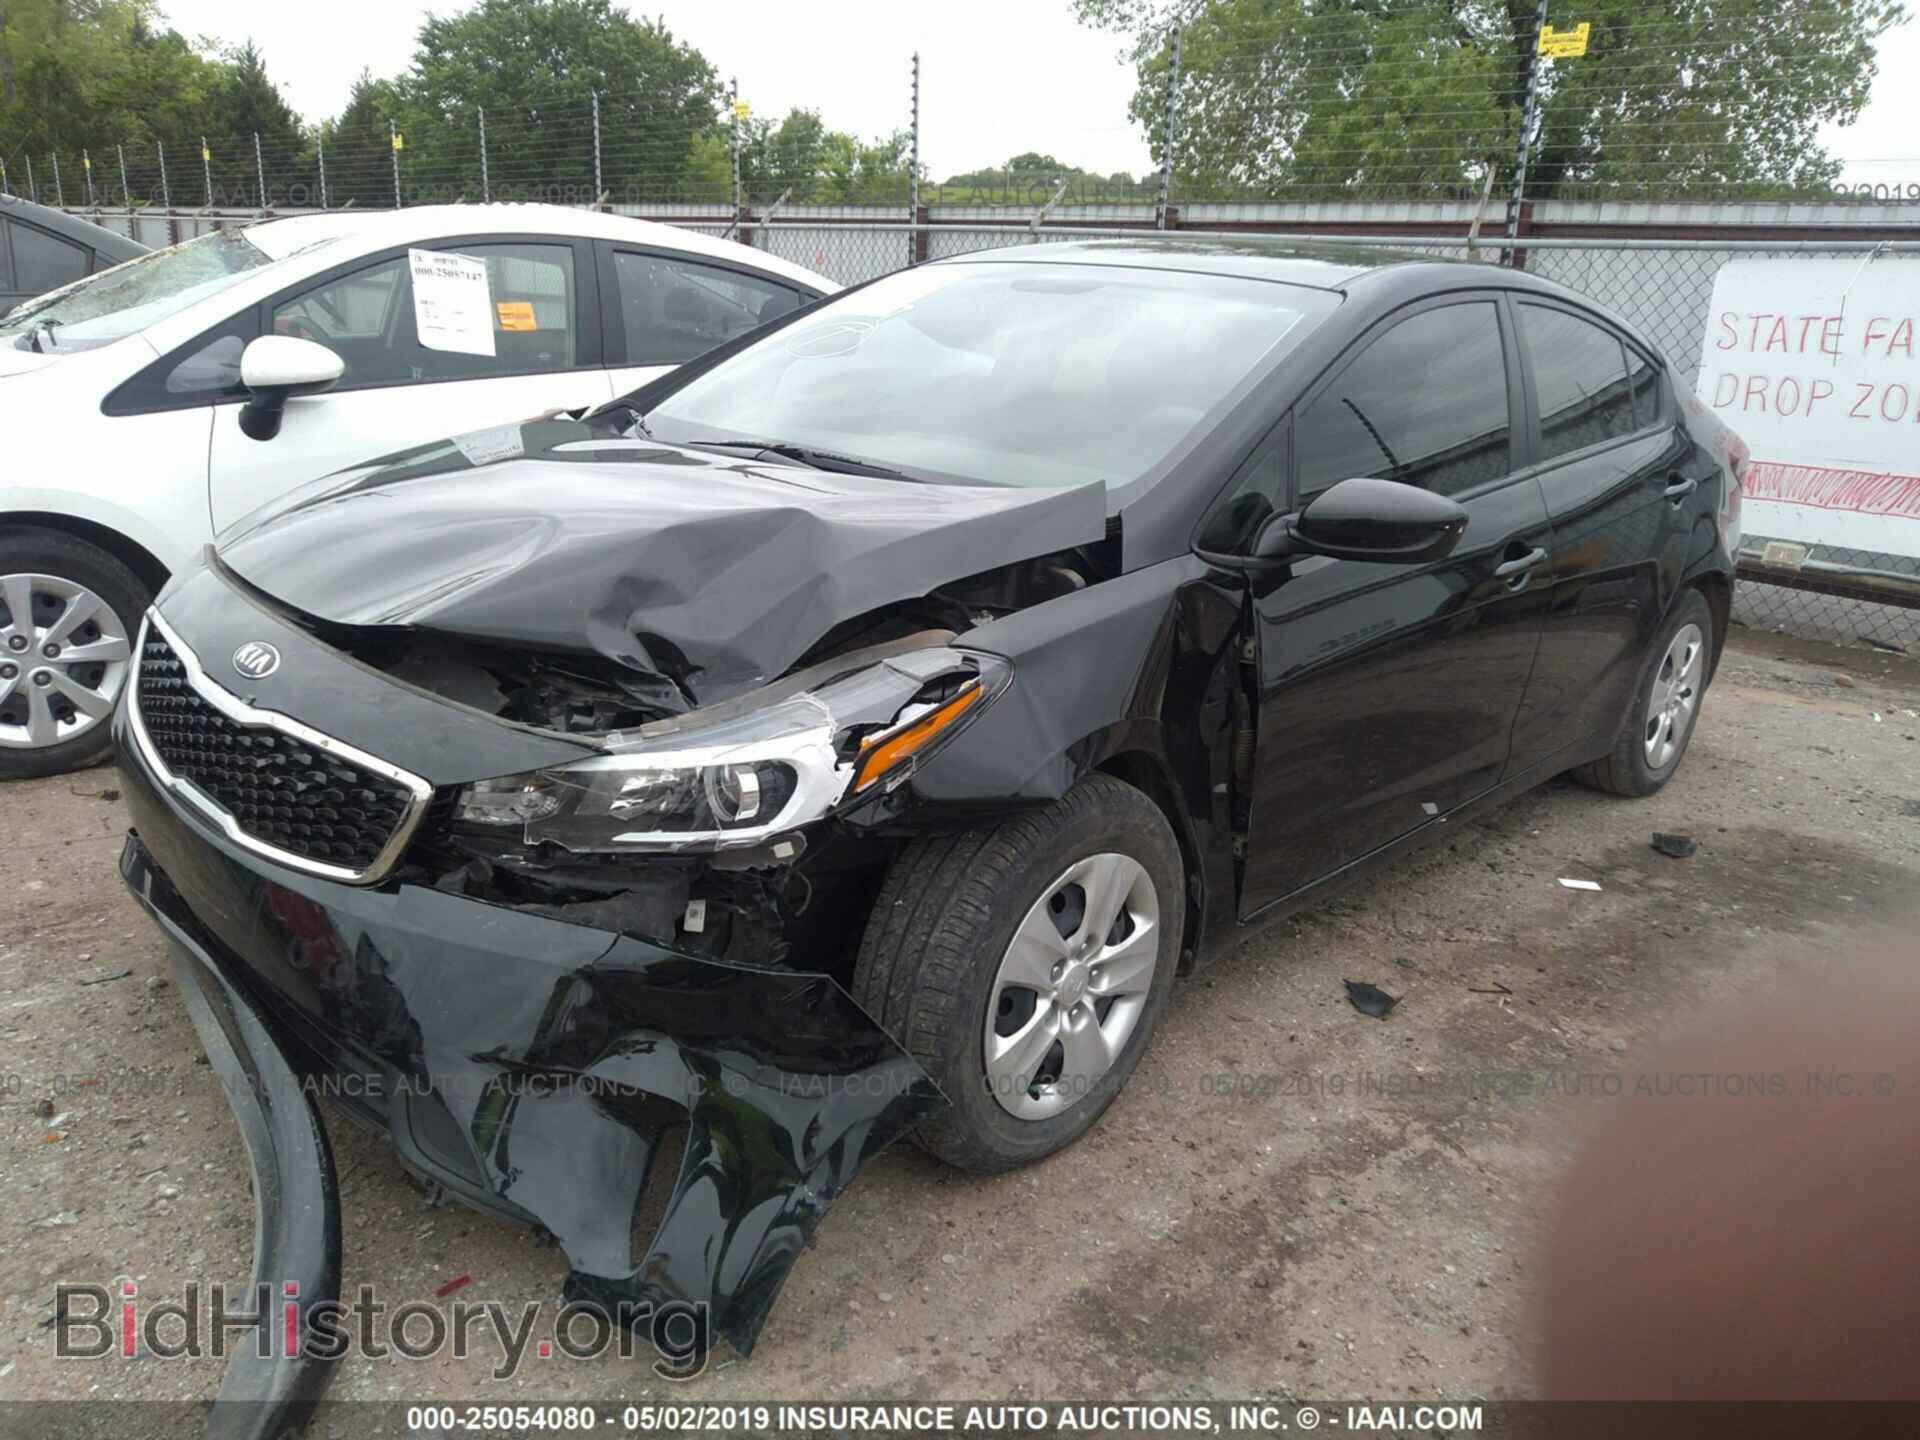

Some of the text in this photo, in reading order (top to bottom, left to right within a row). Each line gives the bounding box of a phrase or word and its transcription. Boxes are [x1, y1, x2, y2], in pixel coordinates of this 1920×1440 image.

[1716, 311, 1844, 354] STATE
[1713, 373, 1920, 424] DROP ZO
[236, 643, 272, 674] KIA
